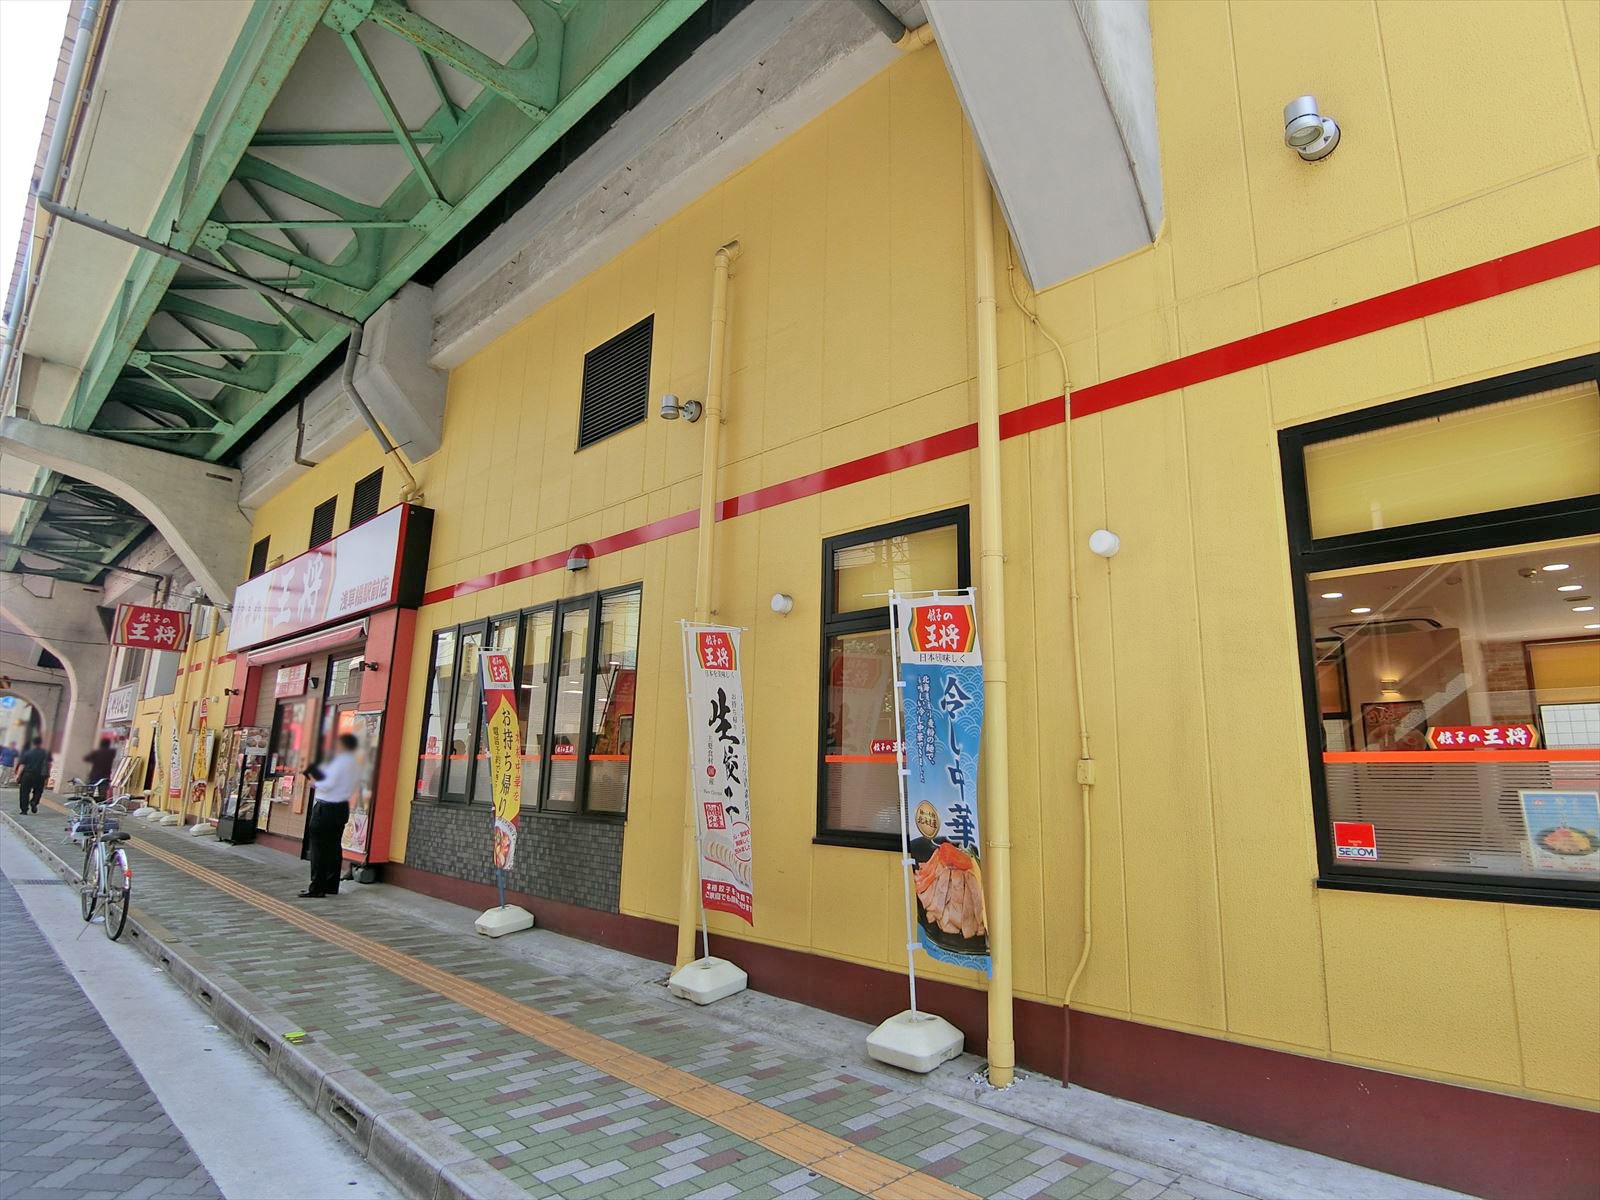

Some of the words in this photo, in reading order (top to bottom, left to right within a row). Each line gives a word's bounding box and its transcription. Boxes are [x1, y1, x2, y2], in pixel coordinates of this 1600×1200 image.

[927, 608, 953, 622] 餃子の
[127, 622, 177, 645] 王将
[924, 623, 960, 650] 王将
[704, 647, 729, 669] 王将
[1437, 727, 1528, 746] 餃子の王将
[498, 707, 514, 818] お持ち帰り
[1338, 847, 1374, 857] SECOM
